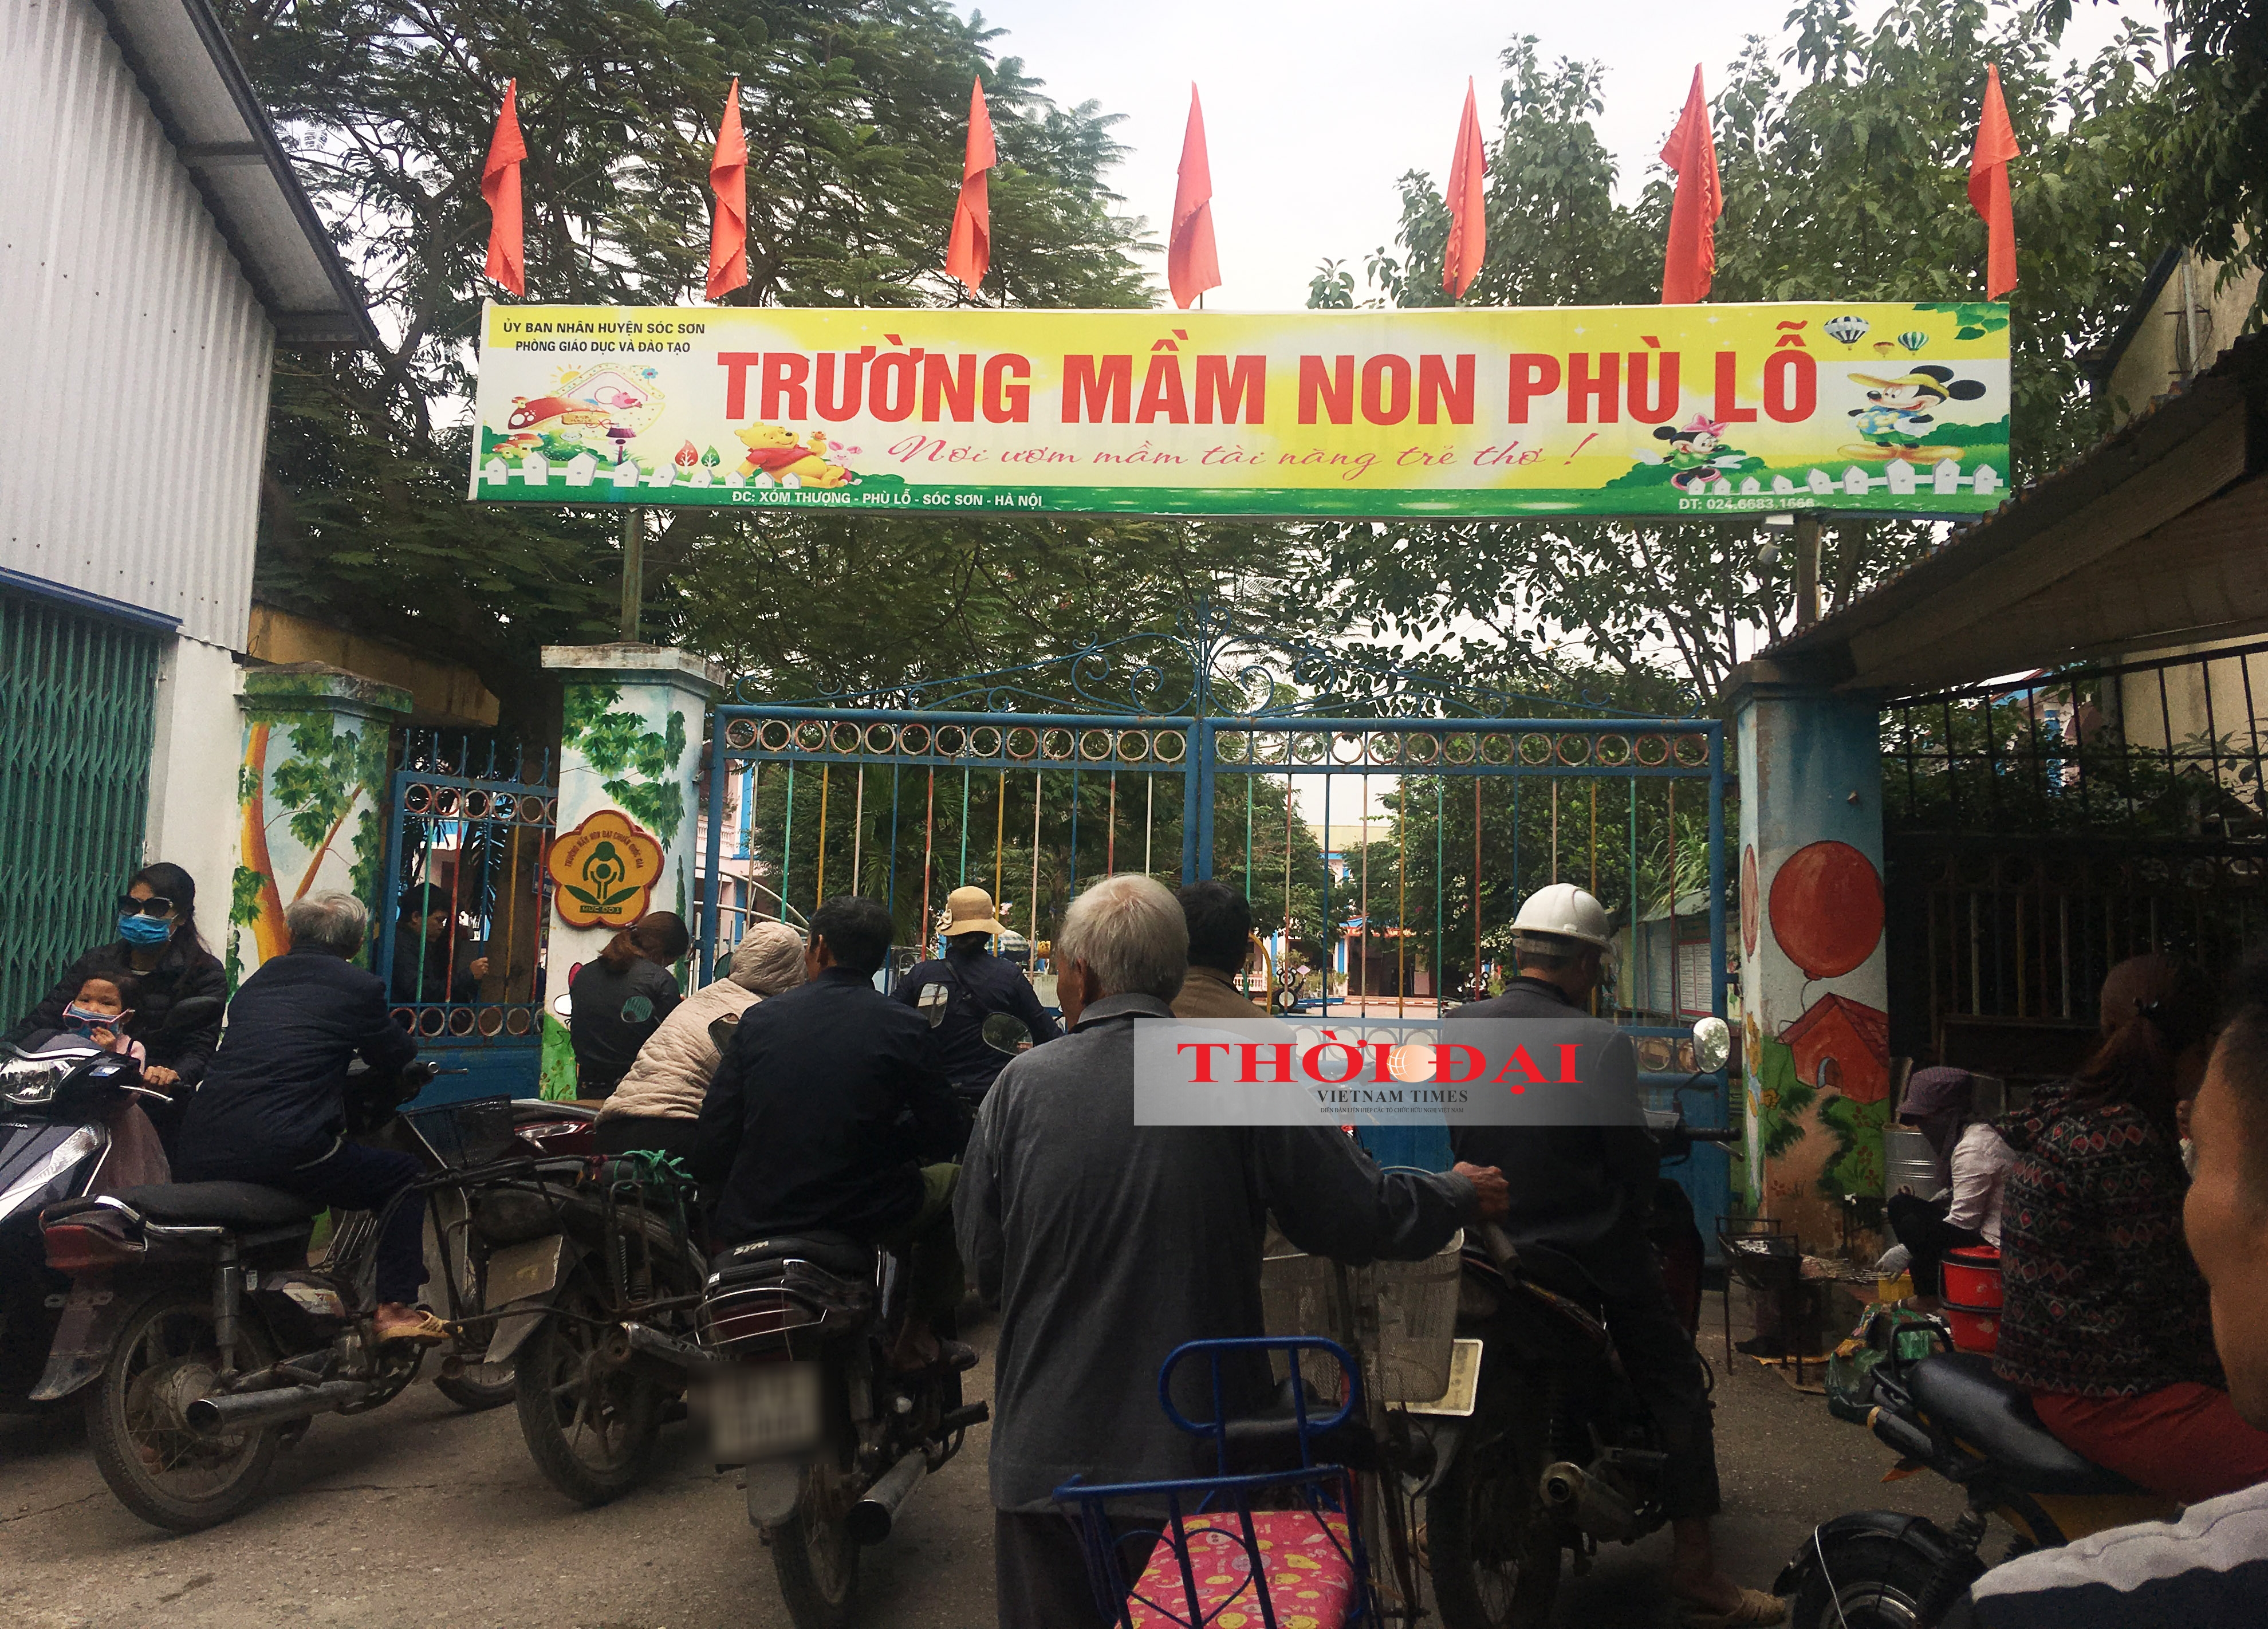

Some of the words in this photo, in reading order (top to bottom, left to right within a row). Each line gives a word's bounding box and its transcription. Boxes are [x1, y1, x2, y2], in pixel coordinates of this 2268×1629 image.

[503, 317, 522, 333] ỦY
[525, 322, 553, 333] BAN
[556, 320, 594, 333] NHÂN
[598, 320, 643, 336] HUYỆN
[646, 320, 674, 334] SÓC
[677, 323, 706, 334] SƠN
[515, 339, 556, 352] PHÒNG
[559, 339, 588, 352] GIÁO
[590, 341, 616, 355] DỤC
[619, 339, 635, 352] VÀ
[637, 339, 664, 353] ĐÀO
[667, 342, 691, 356] TẠO
[717, 333, 1031, 423] TRƯỜNG
[1061, 328, 1267, 425] MẦM
[1297, 353, 1476, 425] NON
[1507, 335, 1680, 424] PHÙ
[1714, 320, 1818, 424] LỖ
[887, 435, 990, 463] Nơi
[1001, 446, 1082, 465] ươm
[1093, 440, 1189, 465] mầm
[1201, 444, 1267, 466] tài
[1278, 447, 1383, 481] năng
[1396, 444, 1458, 467] trẻ
[1474, 440, 1548, 467] thơ
[731, 491, 755, 502] ĐC:
[758, 489, 790, 503] XÓM
[794, 491, 851, 506] THƯỢNG
[862, 490, 891, 504] PHÙ
[893, 488, 912, 505] LỖ
[922, 490, 951, 506] SÓC
[954, 493, 983, 506] SƠN
[994, 492, 1014, 506] HÀ
[1018, 492, 1042, 510] NỘI
